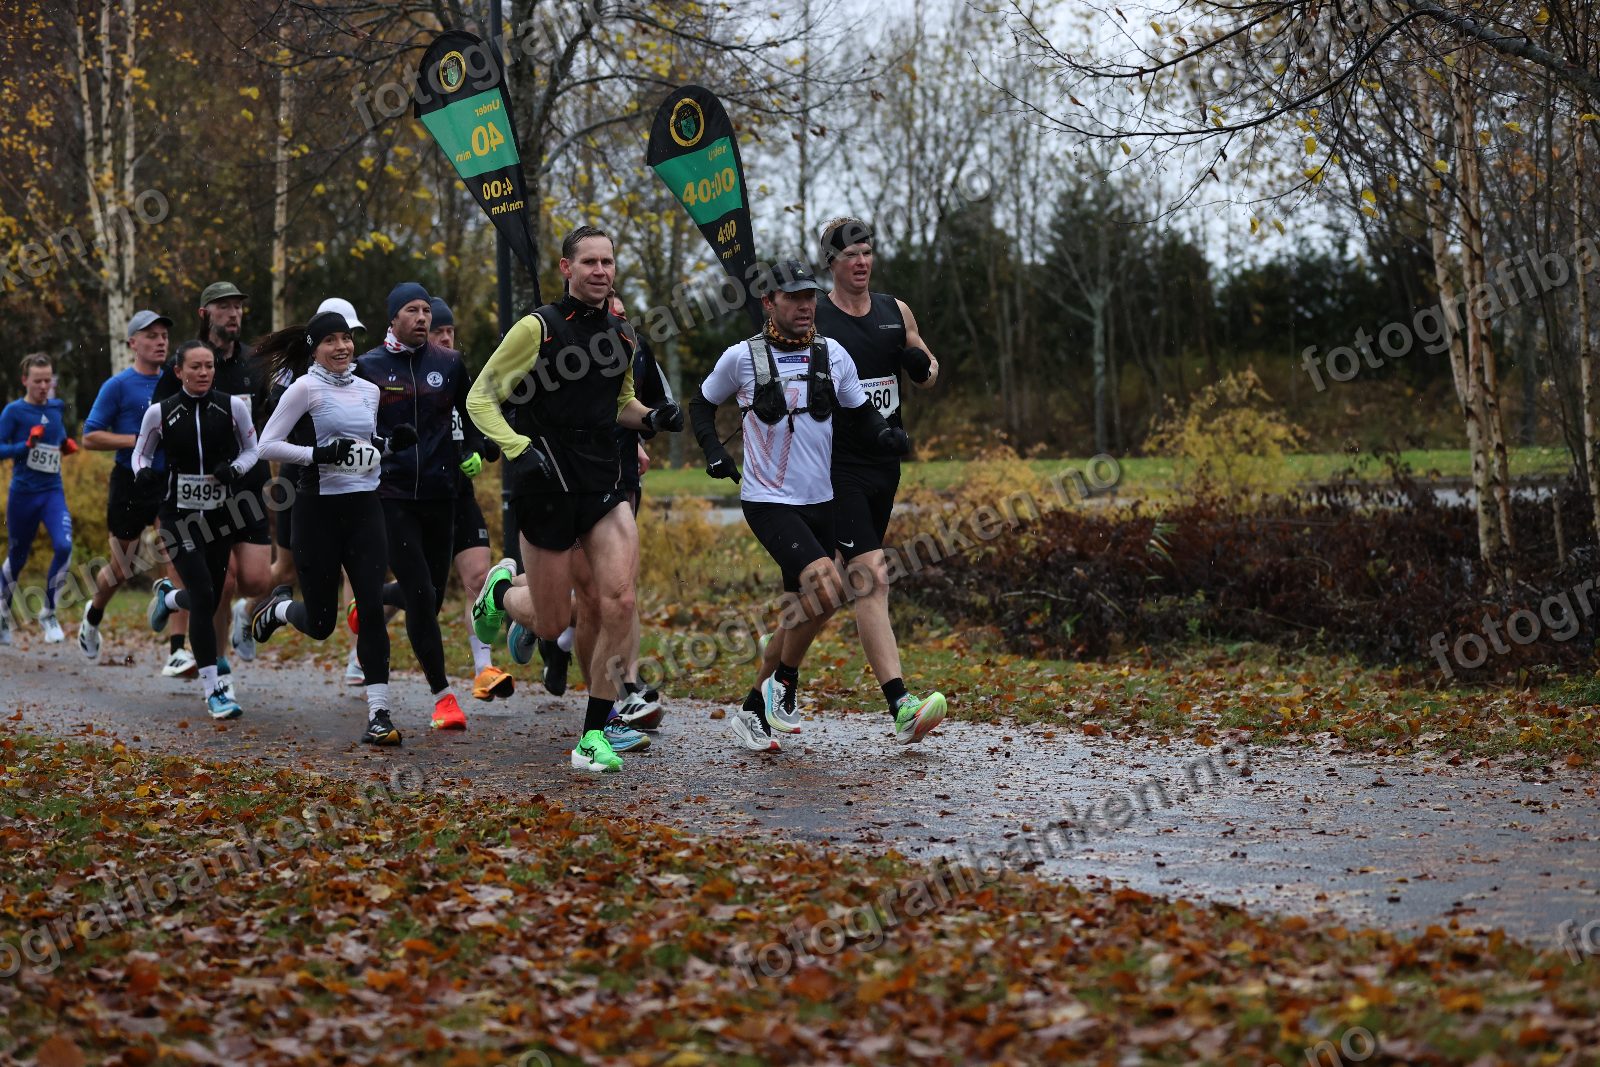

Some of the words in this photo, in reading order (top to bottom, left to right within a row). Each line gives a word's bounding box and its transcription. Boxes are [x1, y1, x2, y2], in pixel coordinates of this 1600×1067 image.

[682, 167, 736, 207] 40:00
[717, 219, 737, 245] 4:00
[182, 483, 221, 501] 9495
